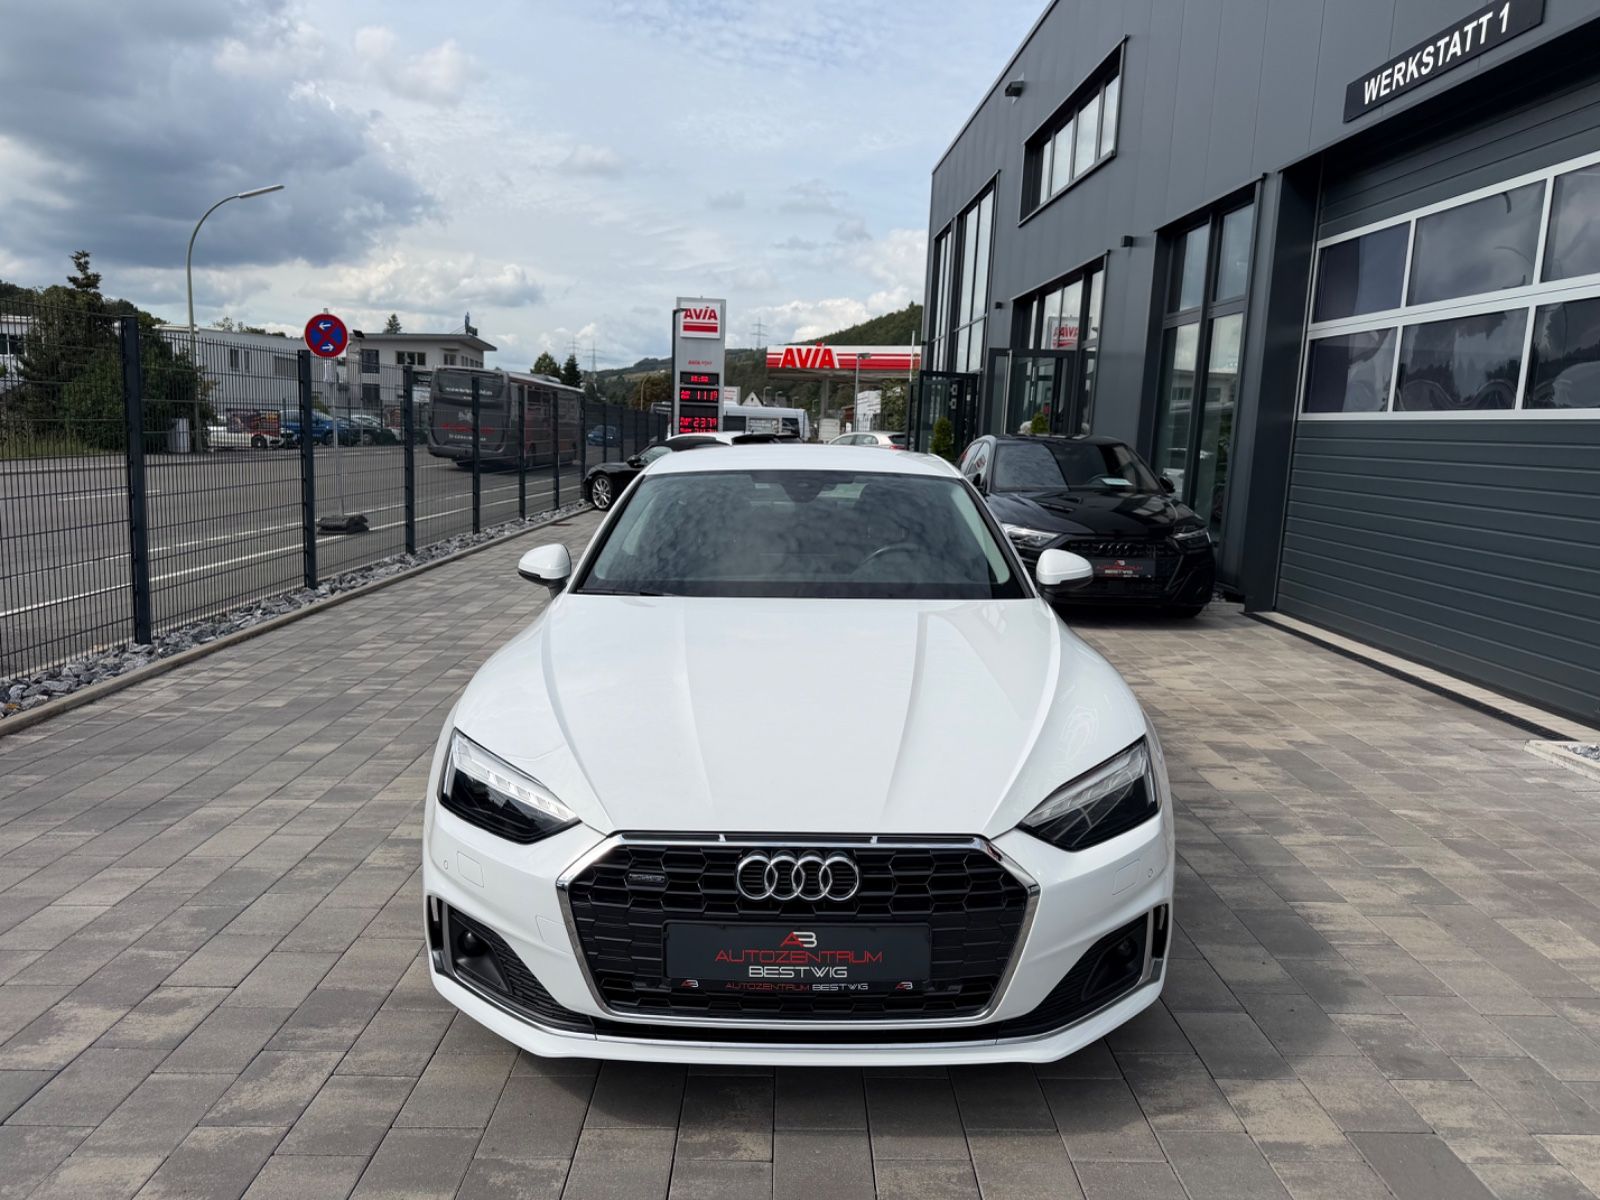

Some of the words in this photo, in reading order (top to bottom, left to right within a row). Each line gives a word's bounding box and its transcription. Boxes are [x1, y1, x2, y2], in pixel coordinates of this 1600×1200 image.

[1364, 11, 1493, 105] WERKSTATT
[1499, 2, 1510, 33] 1
[780, 341, 837, 369] AVIA
[715, 949, 883, 963] AUTOZENTRUM
[748, 965, 848, 978] BESTWIG
[725, 982, 810, 992] AUTOZENTRUM
[812, 983, 869, 991] BESTWIG
